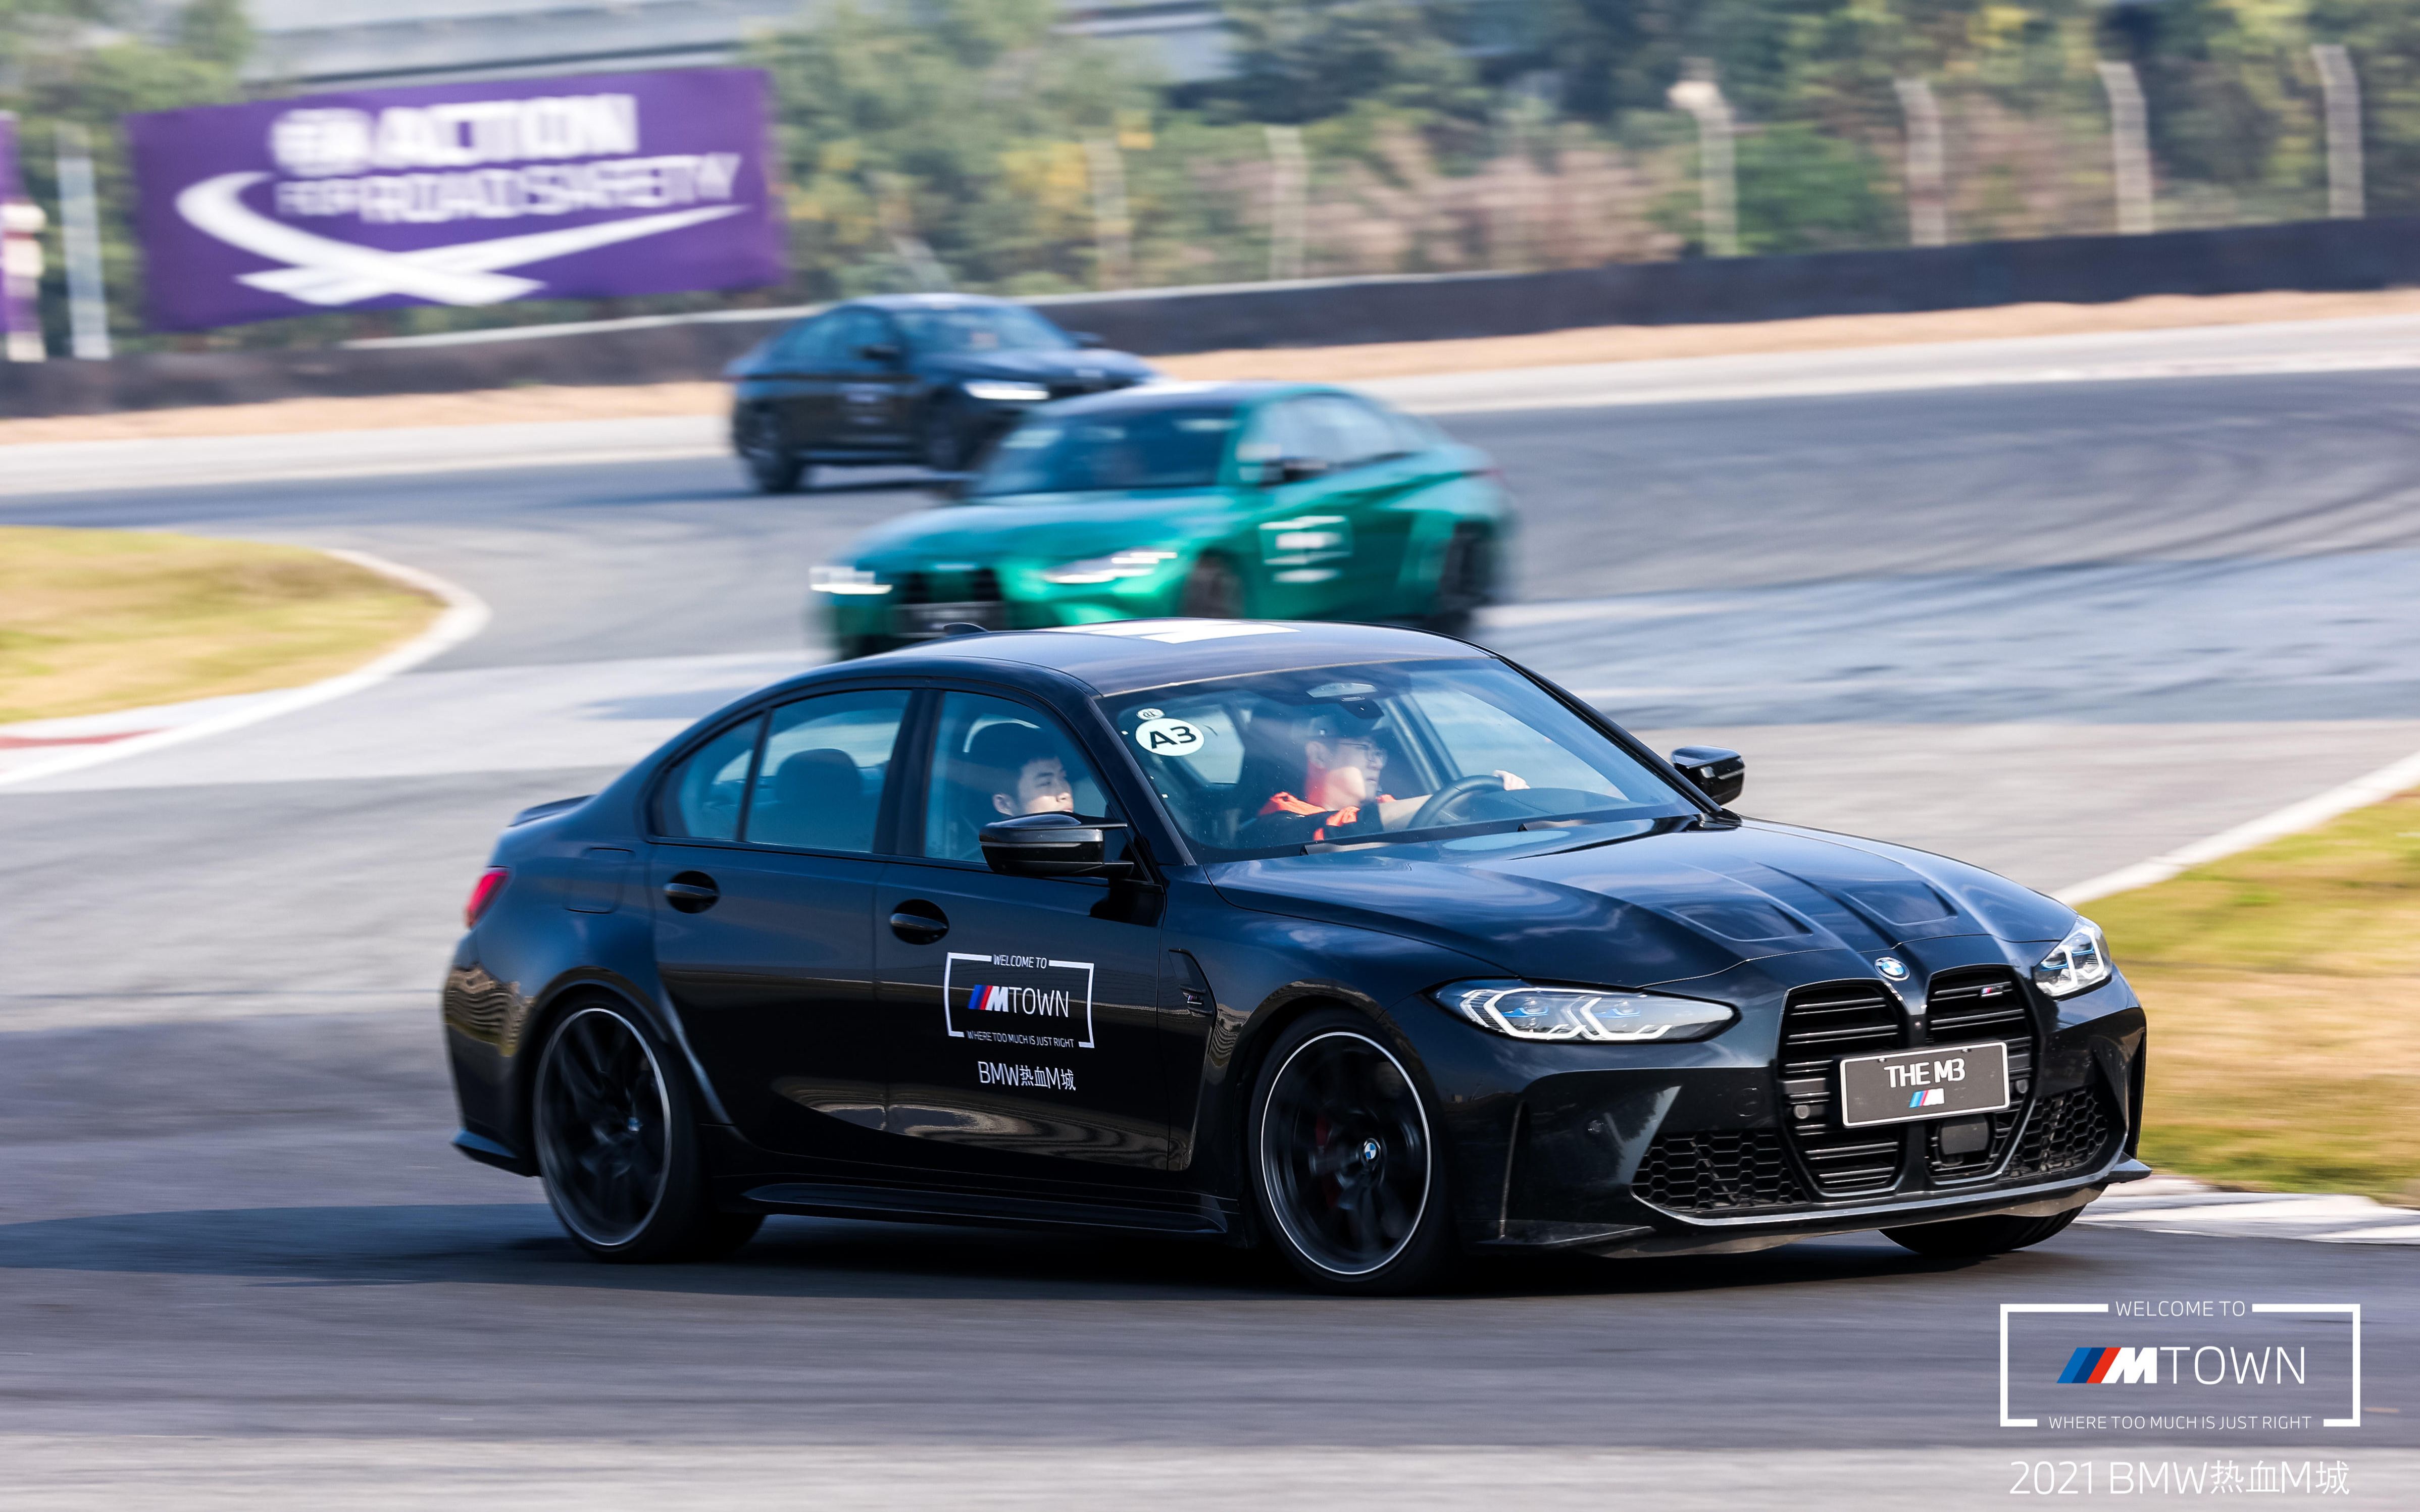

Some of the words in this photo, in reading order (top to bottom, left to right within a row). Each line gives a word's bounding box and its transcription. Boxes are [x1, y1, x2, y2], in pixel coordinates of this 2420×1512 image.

[378, 93, 639, 170] ACTION
[1149, 725, 1196, 749] A3
[993, 954, 1035, 968] WELCOME
[1035, 957, 1047, 969] TO
[966, 1030, 992, 1041] WHERE
[992, 1032, 1007, 1042] TOO
[1007, 1033, 1028, 1044] MUCH
[1029, 1035, 1036, 1045] IS
[1036, 1036, 1052, 1046] JUST
[1053, 1037, 1074, 1048] RIGHT
[978, 1061, 1076, 1091] BMW热血M城
[1884, 1062, 1931, 1088] THE
[1934, 1058, 1965, 1083] M3
